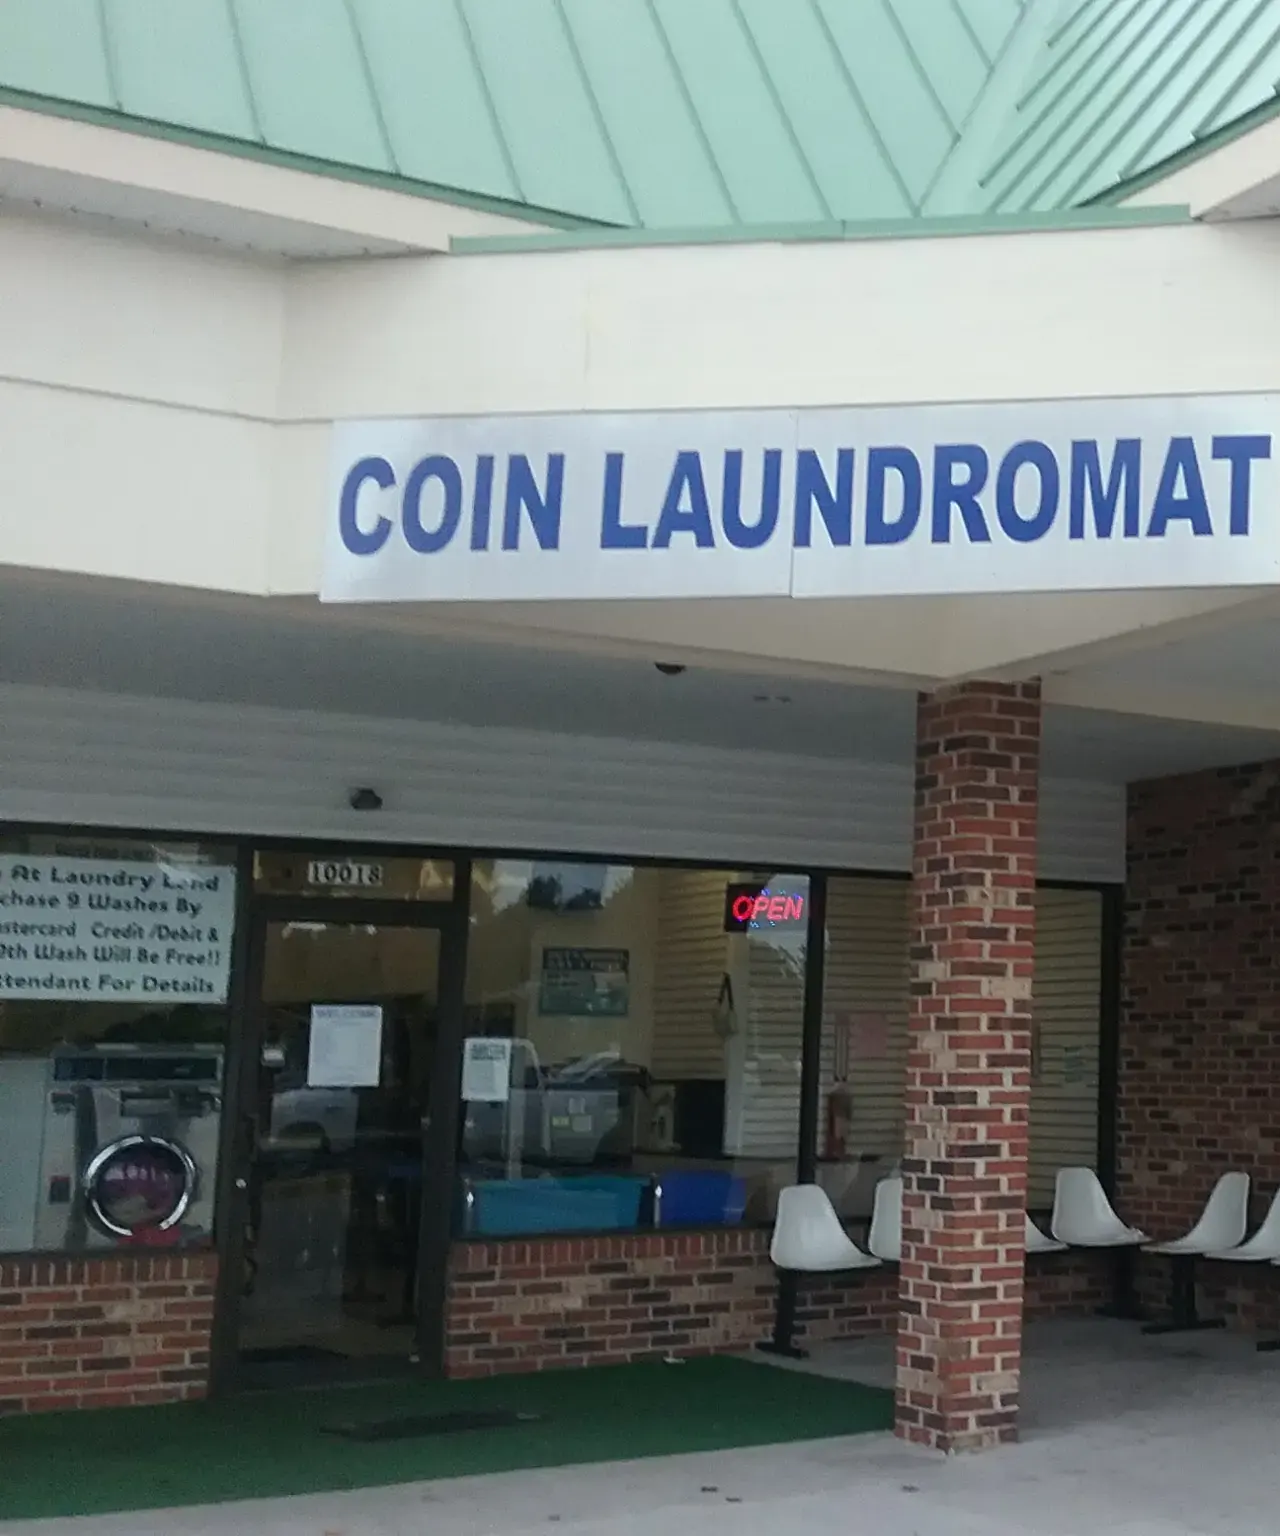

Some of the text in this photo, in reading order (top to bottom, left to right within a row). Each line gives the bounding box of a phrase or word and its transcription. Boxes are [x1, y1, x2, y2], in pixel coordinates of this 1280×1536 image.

[338, 434, 1273, 555] COIN LAUNDROMAT
[11, 865, 220, 892] At Laundry Lnd
[312, 863, 380, 883] 10018
[68, 891, 80, 909] 9
[88, 893, 168, 912] Washes
[176, 897, 203, 918] By
[732, 895, 803, 920] OPEN
[91, 921, 145, 939] Credit
[34, 944, 87, 961] Wash
[93, 945, 131, 962] Will
[137, 946, 160, 964] Be
[166, 948, 220, 966] Free!!
[0, 972, 215, 993] tendant For Details
